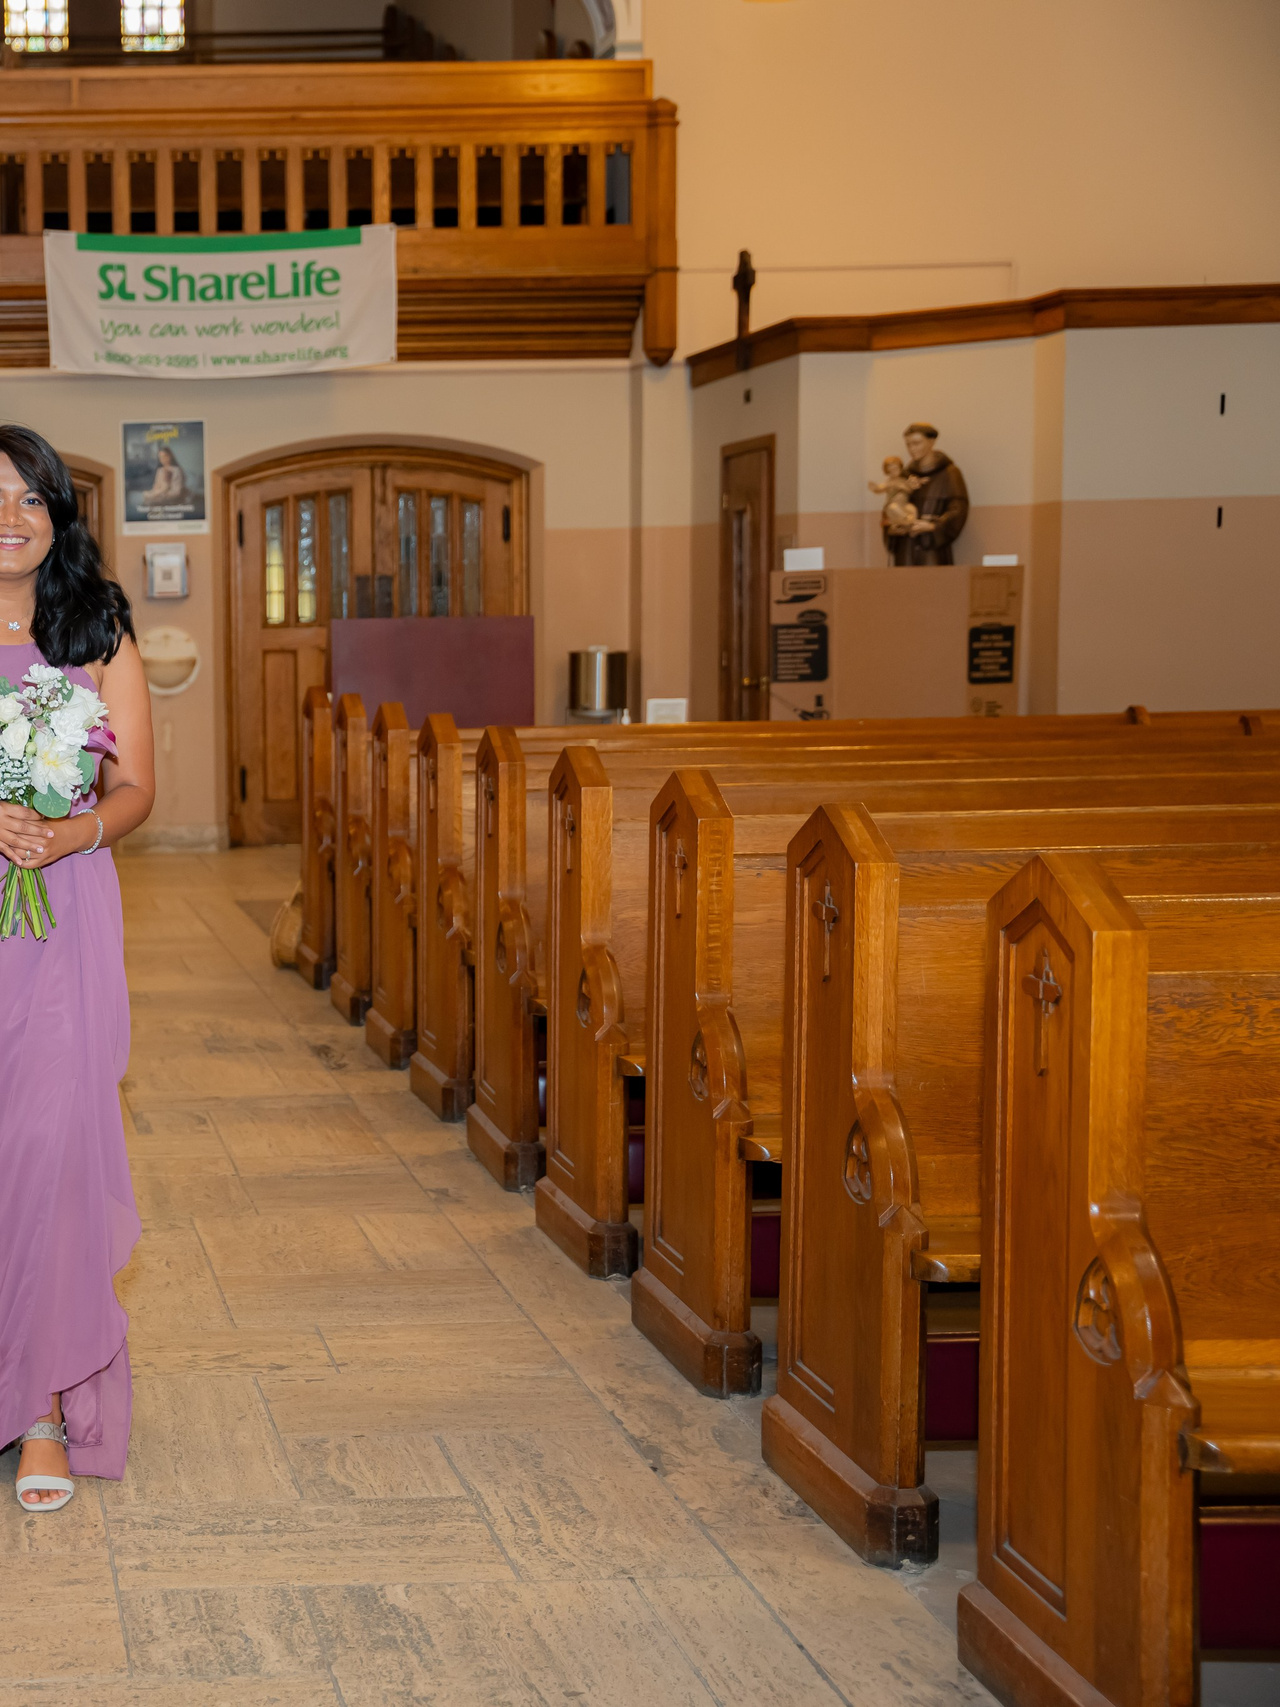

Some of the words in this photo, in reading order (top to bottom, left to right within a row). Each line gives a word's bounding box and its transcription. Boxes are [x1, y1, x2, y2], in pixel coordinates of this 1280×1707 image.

[143, 260, 341, 302] ShareLife
[99, 318, 142, 344] You
[148, 322, 188, 339] can
[194, 316, 244, 338] work
[250, 309, 341, 337] wonders!
[209, 345, 349, 367] www.sharelife.org
